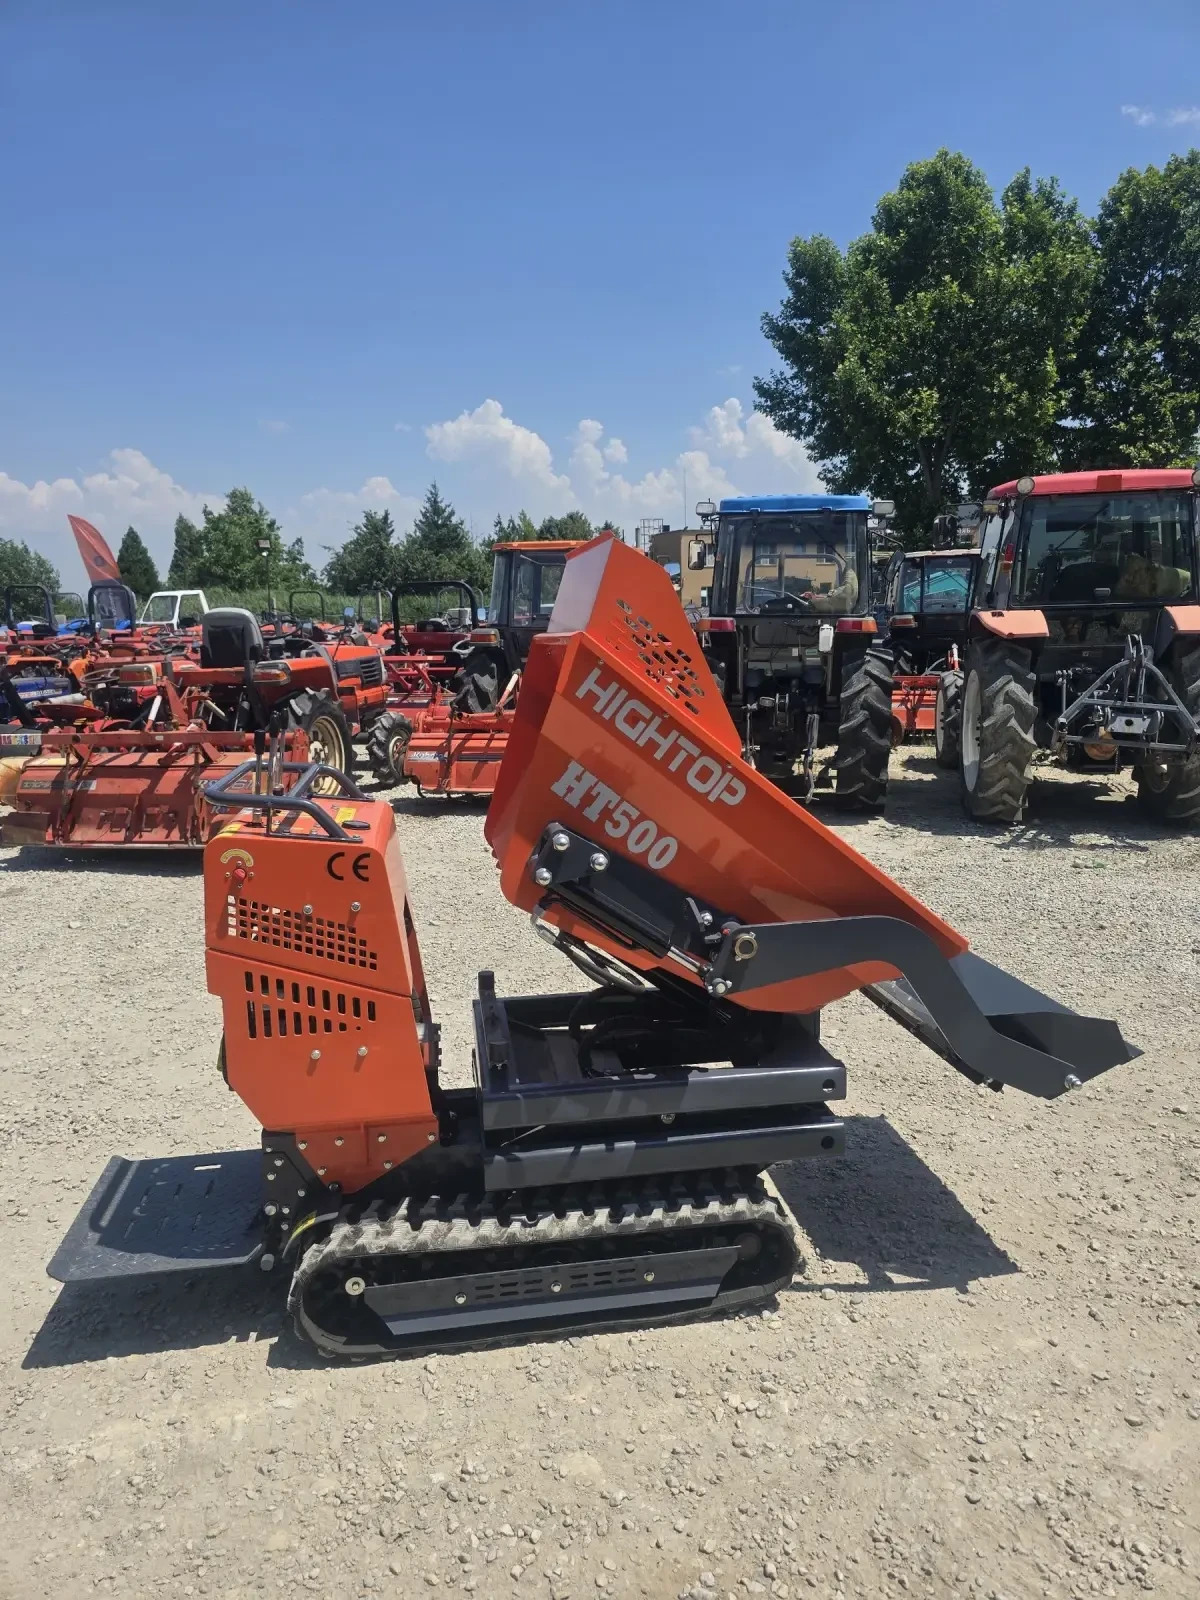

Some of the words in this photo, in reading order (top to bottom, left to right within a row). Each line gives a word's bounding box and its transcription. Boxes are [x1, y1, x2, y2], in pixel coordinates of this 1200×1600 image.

[575, 667, 747, 806] HIGHTOP
[326, 851, 371, 882] CE
[550, 760, 678, 870] HT500
